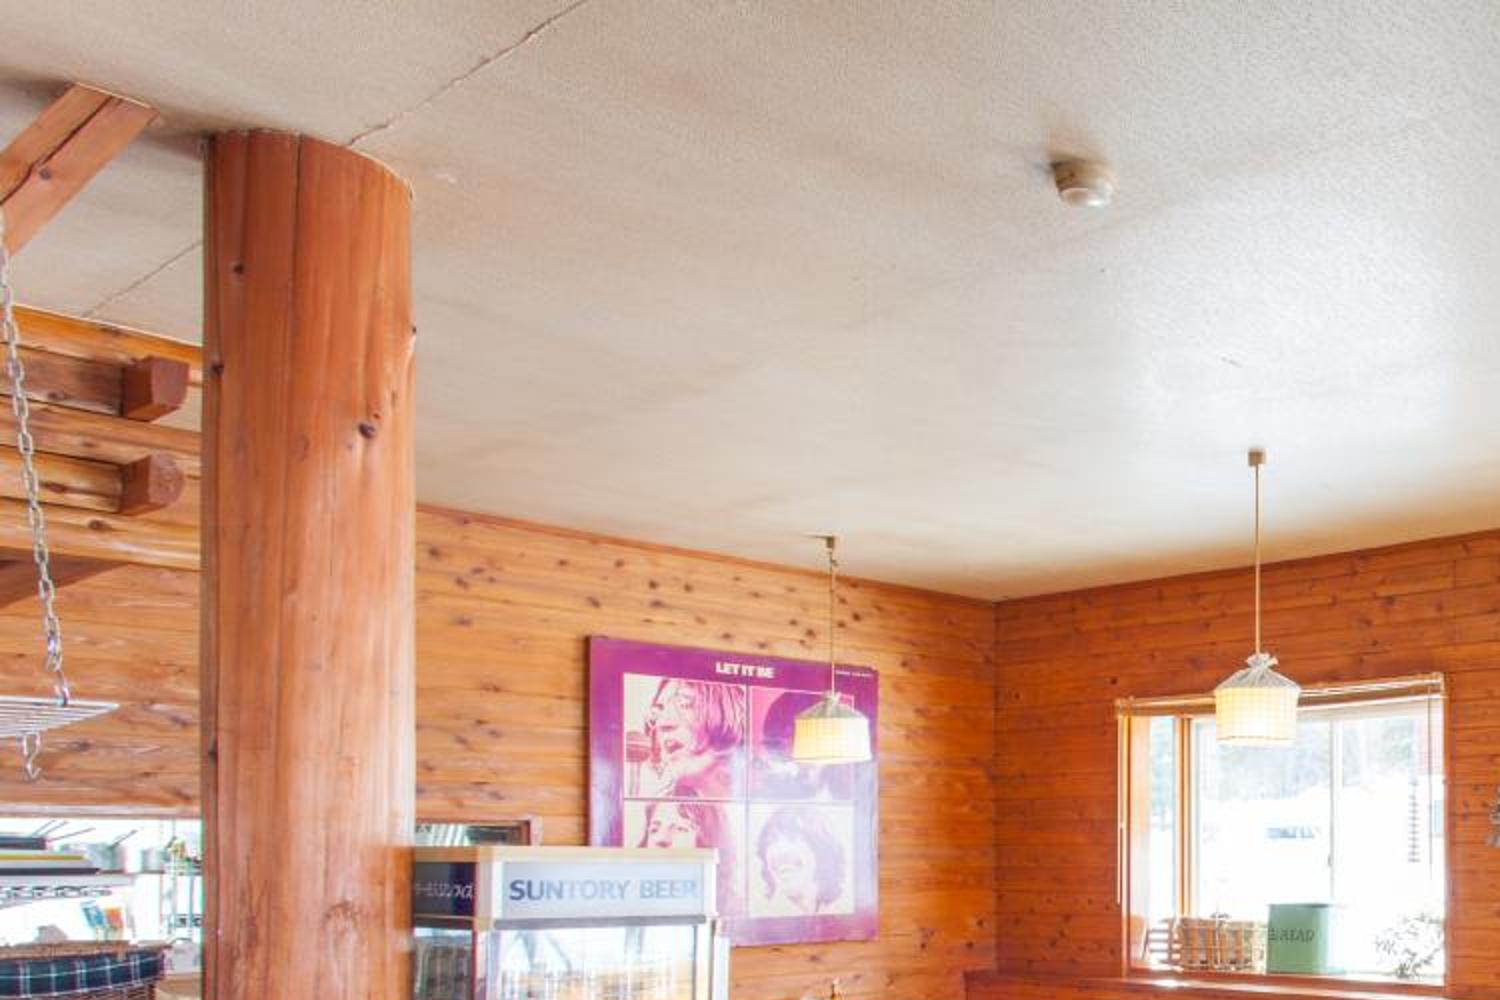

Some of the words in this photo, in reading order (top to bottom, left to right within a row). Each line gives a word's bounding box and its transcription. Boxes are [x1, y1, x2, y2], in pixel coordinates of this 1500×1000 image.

[715, 661, 739, 675] LET
[741, 664, 754, 677] IT
[756, 666, 777, 679] BE
[508, 879, 632, 901] SUNTORY
[640, 879, 697, 900] BEER
[1267, 927, 1316, 942] BREAD
